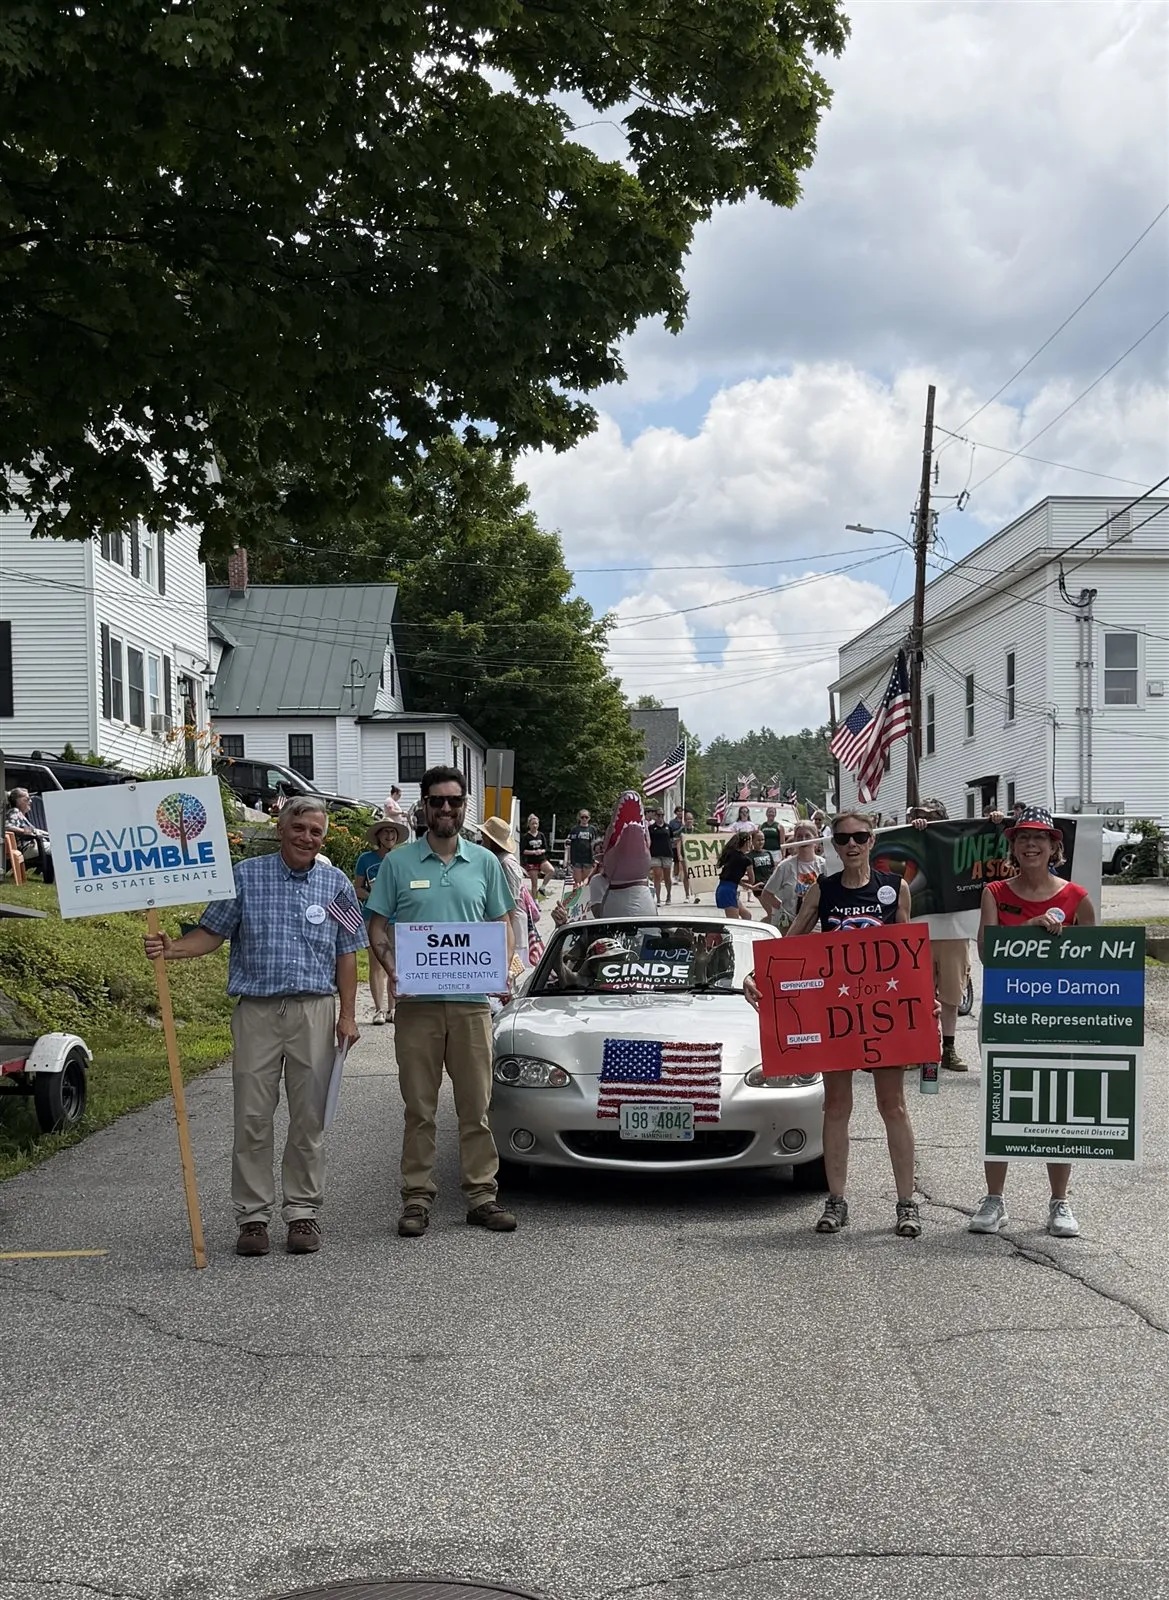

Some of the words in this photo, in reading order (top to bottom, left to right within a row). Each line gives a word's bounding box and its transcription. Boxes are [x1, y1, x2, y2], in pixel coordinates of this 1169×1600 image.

[66, 825, 158, 855] DAVID
[70, 841, 216, 878] TRUMBLE
[953, 833, 1008, 875] UNEA
[687, 864, 721, 880] ATHL
[971, 860, 983, 880] A
[75, 884, 104, 894] FOR
[112, 877, 156, 890] STATE
[163, 870, 218, 883] SENATE
[427, 933, 470, 948] SAM
[993, 939, 1052, 958] HOPE
[1060, 940, 1092, 959] for
[1100, 940, 1136, 959] NH
[416, 951, 492, 967] DEERING
[818, 938, 925, 978] JUDY
[405, 972, 430, 980] STATE
[431, 971, 499, 980] REPRESENTATIVE
[601, 962, 690, 978] CINDE
[605, 976, 686, 984] WARMINGTON
[781, 980, 824, 990] SPRINGFIELD
[853, 977, 881, 999] for
[1007, 978, 1052, 997] Hope
[1058, 979, 1120, 995] Damon
[826, 998, 921, 1038] DIST
[993, 1012, 1028, 1025] State
[1031, 1013, 1133, 1027] Representative
[789, 1035, 820, 1043] SUNAPEE
[863, 1037, 882, 1063] 5
[993, 1070, 1002, 1089] LIOT
[992, 1092, 1001, 1121] KAREN
[1002, 1069, 1130, 1125] HILL
[625, 1111, 648, 1129] 198
[657, 1111, 691, 1130] 4842
[1023, 1126, 1059, 1135] Executive
[1061, 1127, 1090, 1136] Council
[1091, 1128, 1119, 1136] District
[1005, 1144, 1114, 1156] www.KarenLiotHill.com
